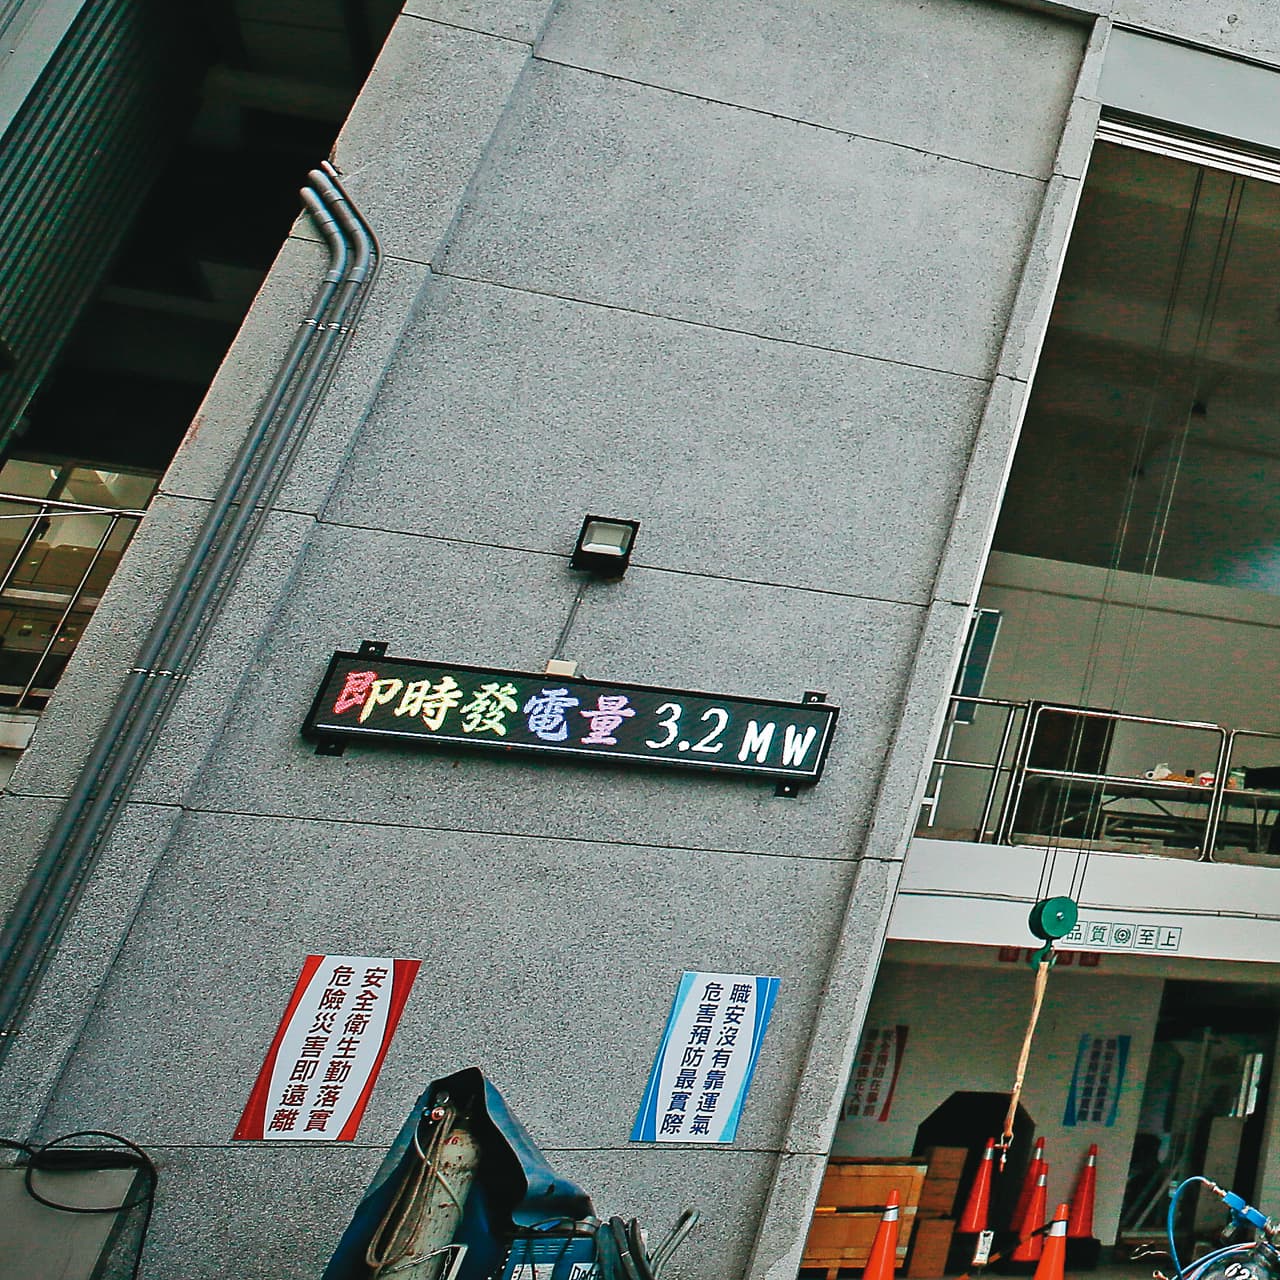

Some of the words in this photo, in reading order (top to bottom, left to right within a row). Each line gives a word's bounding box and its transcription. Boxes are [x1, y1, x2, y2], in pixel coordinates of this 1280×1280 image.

[333, 670, 636, 746] 即時發電量
[645, 702, 729, 754] 3.2
[737, 720, 817, 767] MW
[268, 965, 355, 1132] 危險災害即遠離
[303, 966, 389, 1132] 安全衛生勤落實
[659, 981, 724, 1135] 危害預防最實際
[689, 983, 753, 1136] 職安沒有靠運氣
